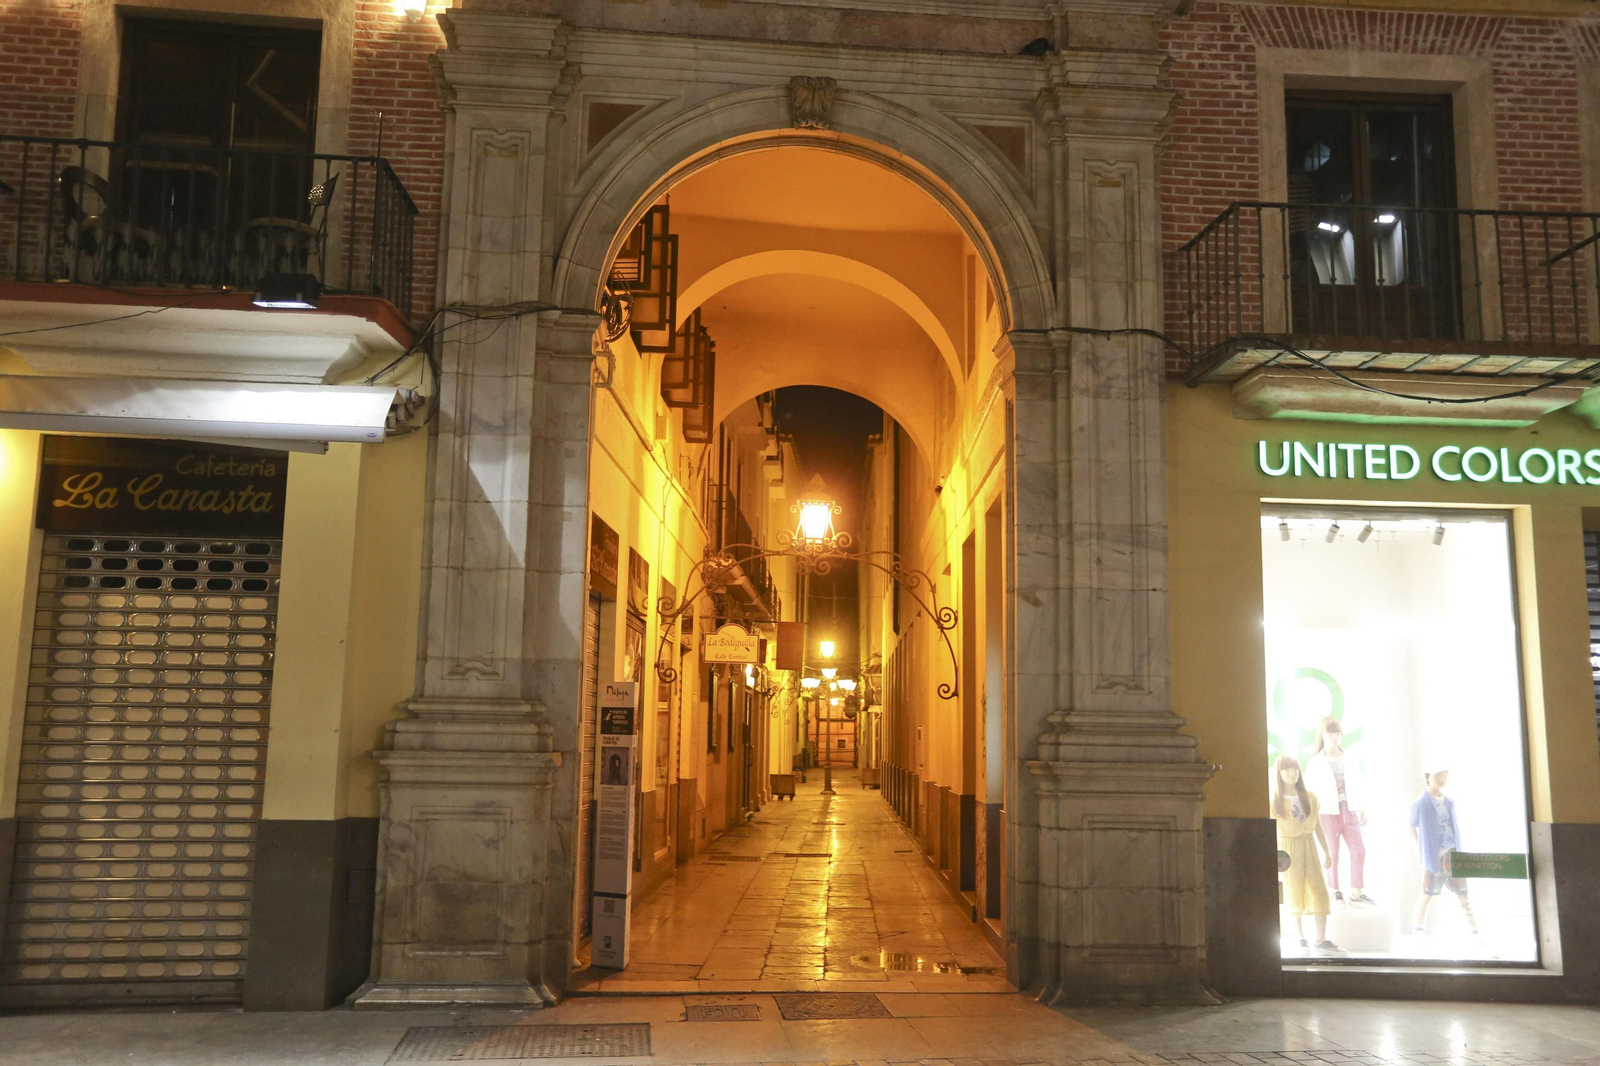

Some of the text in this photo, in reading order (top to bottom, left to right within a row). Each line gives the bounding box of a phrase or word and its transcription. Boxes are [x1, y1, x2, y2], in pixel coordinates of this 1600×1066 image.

[175, 453, 276, 478] Cafetería
[1258, 440, 1600, 485] UNITED COLORS
[52, 471, 274, 515] La Canasta
[707, 637, 718, 647] La
[1452, 854, 1511, 862] UNITED COLORS
